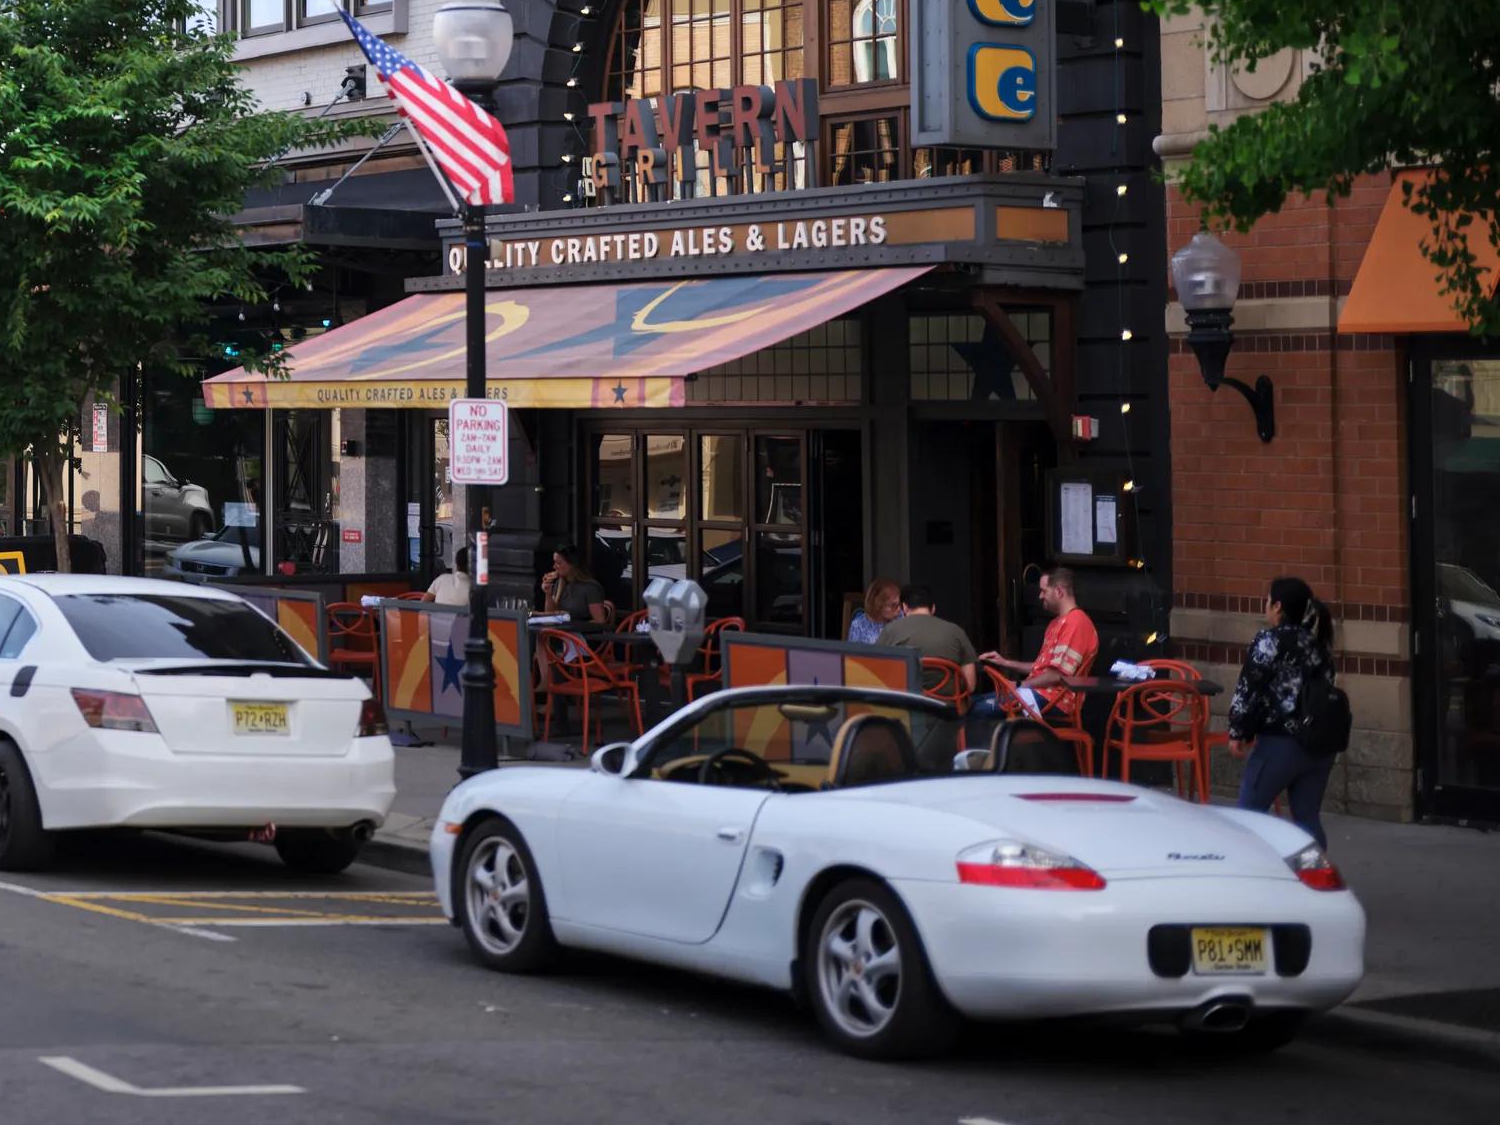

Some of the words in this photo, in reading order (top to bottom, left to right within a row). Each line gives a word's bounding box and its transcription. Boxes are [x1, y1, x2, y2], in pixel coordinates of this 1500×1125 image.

[587, 78, 810, 158] TAVERN
[591, 136, 772, 189] GRILL
[551, 233, 660, 264] CRAFTED
[670, 226, 734, 257] ALES
[746, 224, 765, 252] &
[777, 216, 888, 249] LAGERS
[317, 388, 361, 403] QUALITY
[365, 387, 413, 402] CRAFTED
[419, 387, 445, 400] ALES
[450, 387, 458, 399] &
[469, 404, 487, 417] NO
[456, 419, 501, 432] PARKING
[466, 444, 491, 453] DAILY
[456, 466, 471, 475] WED
[488, 467, 502, 475] SAT
